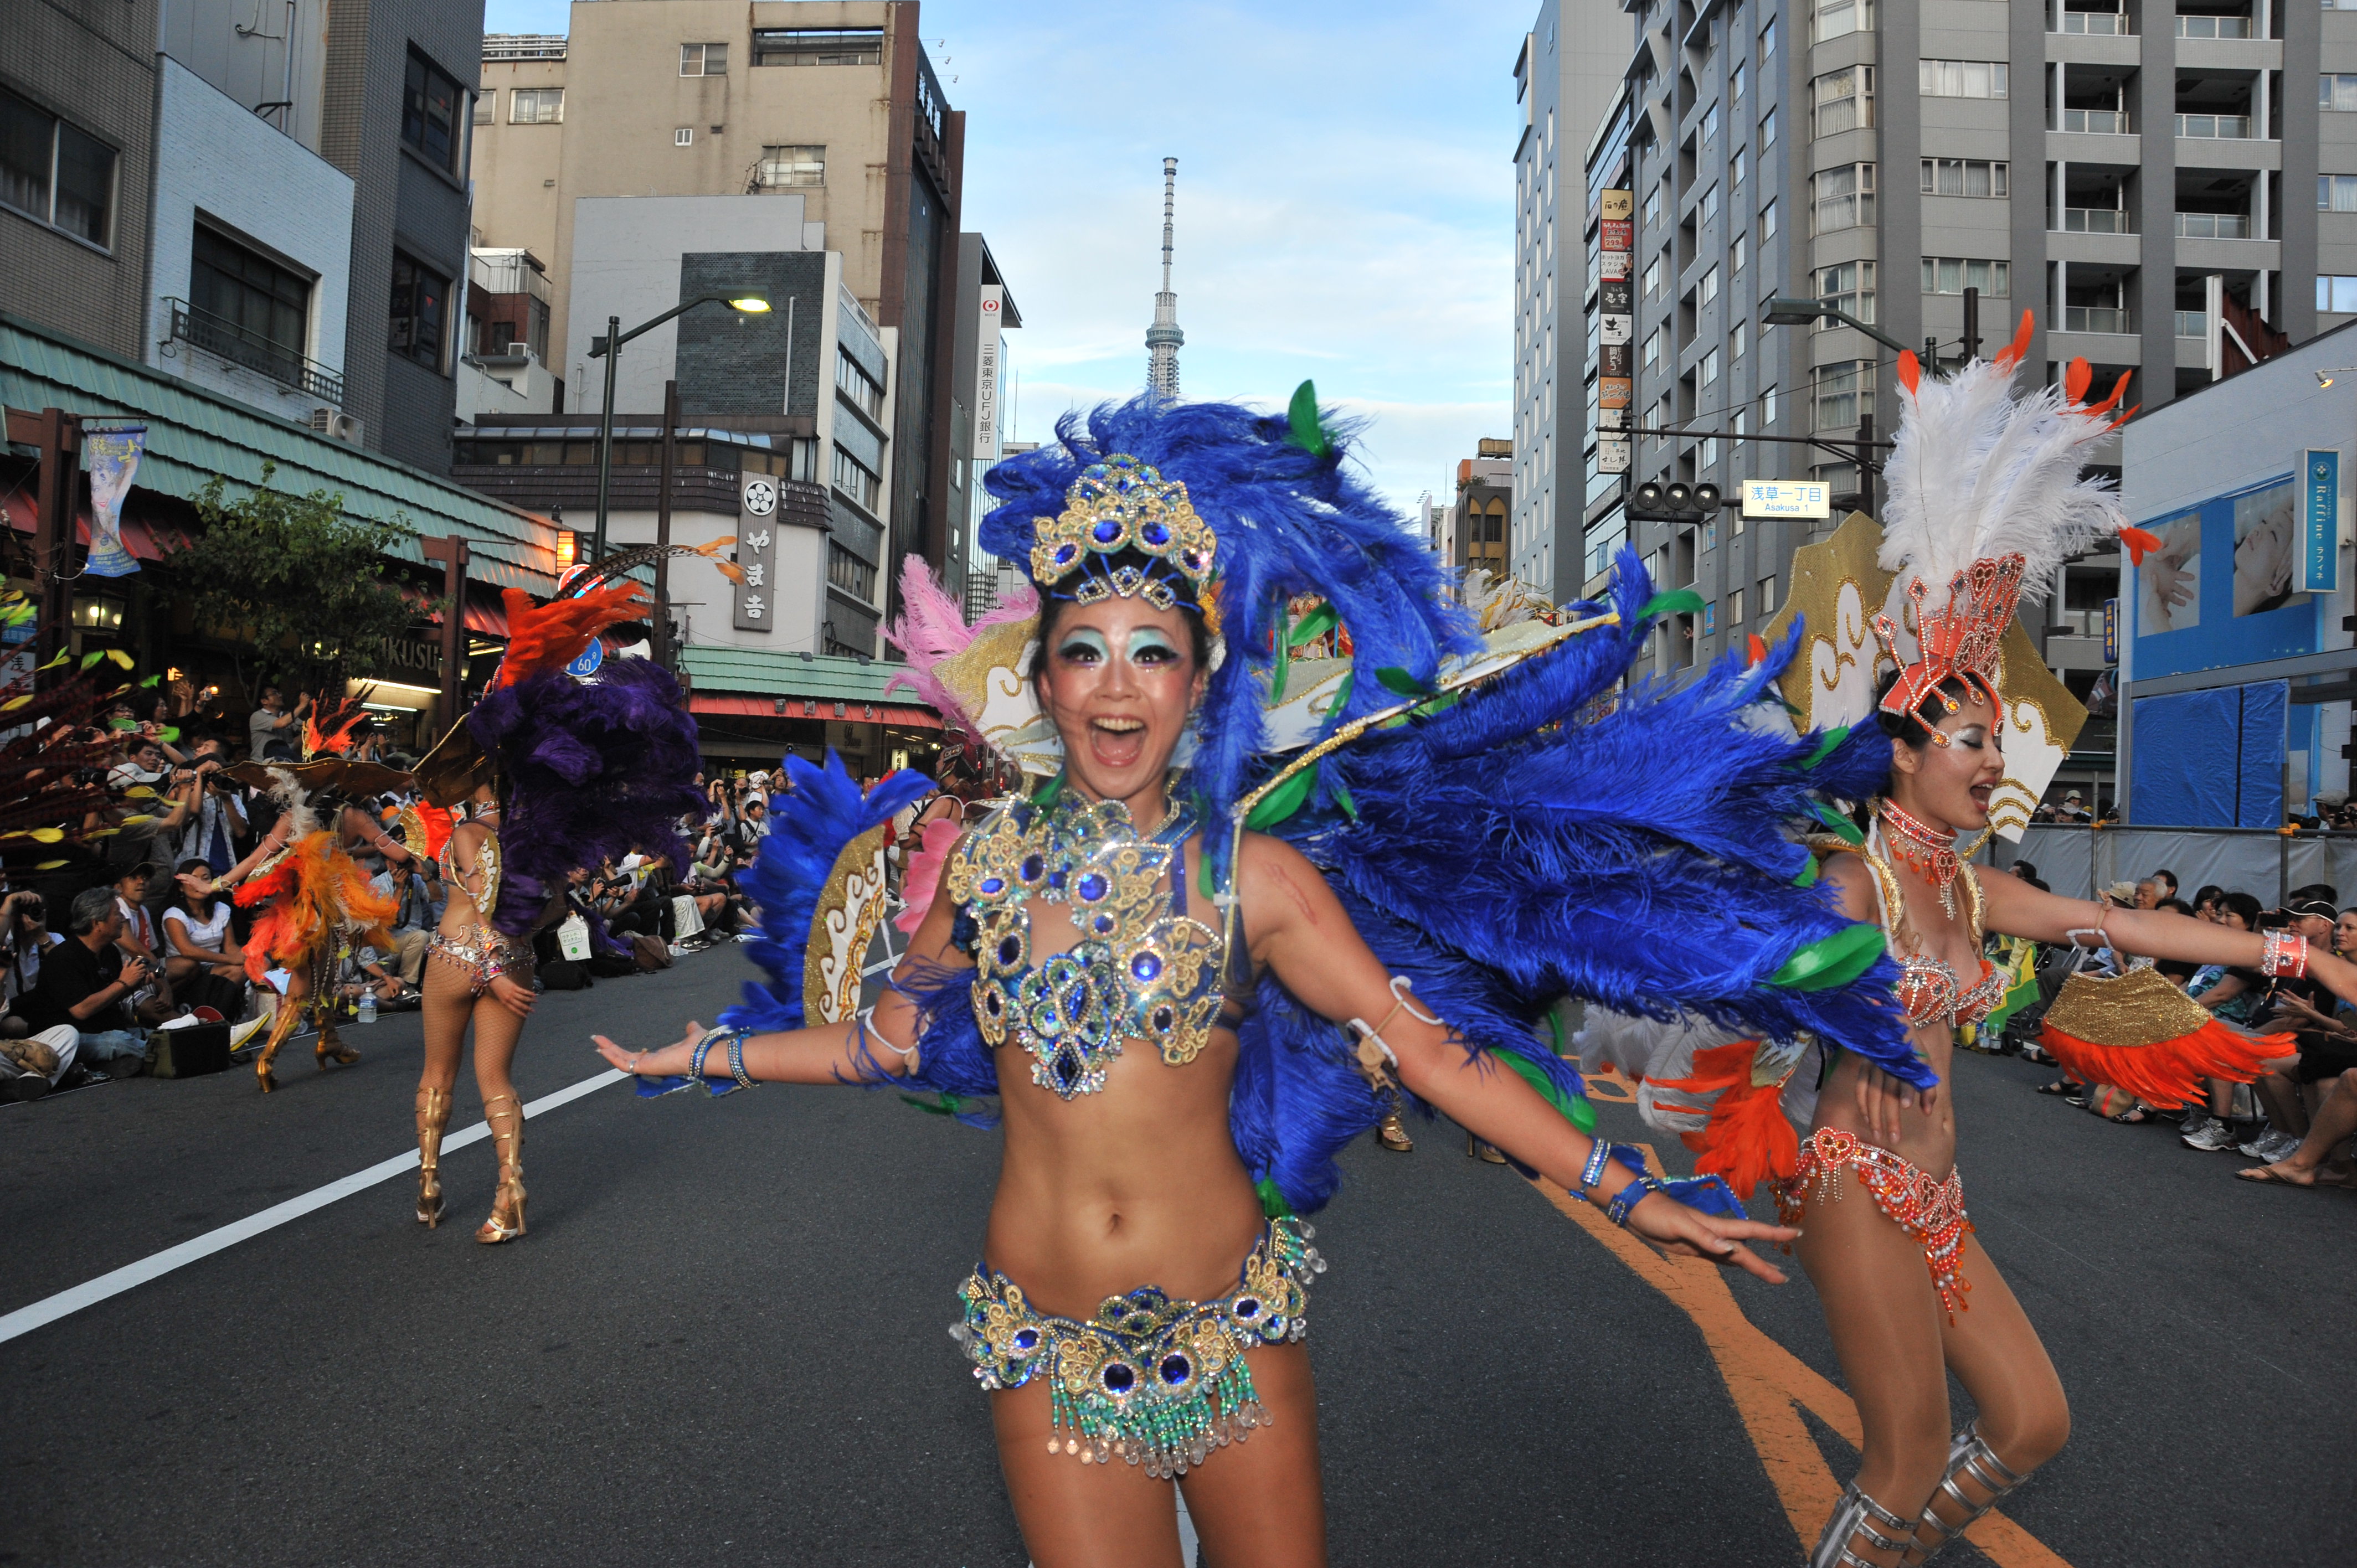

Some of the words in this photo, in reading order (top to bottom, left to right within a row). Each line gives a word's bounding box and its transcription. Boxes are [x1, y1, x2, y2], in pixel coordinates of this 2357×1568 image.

[979, 344, 994, 443] 三菱東京UFJ銀行
[1751, 486, 1821, 502] 浅草一丁目
[1765, 503, 1800, 512] Asakusa
[2316, 486, 2327, 539] Raffine
[744, 529, 770, 618] やま吉
[2316, 546, 2324, 580] ラフィネ
[775, 698, 873, 719] 雷門通り
